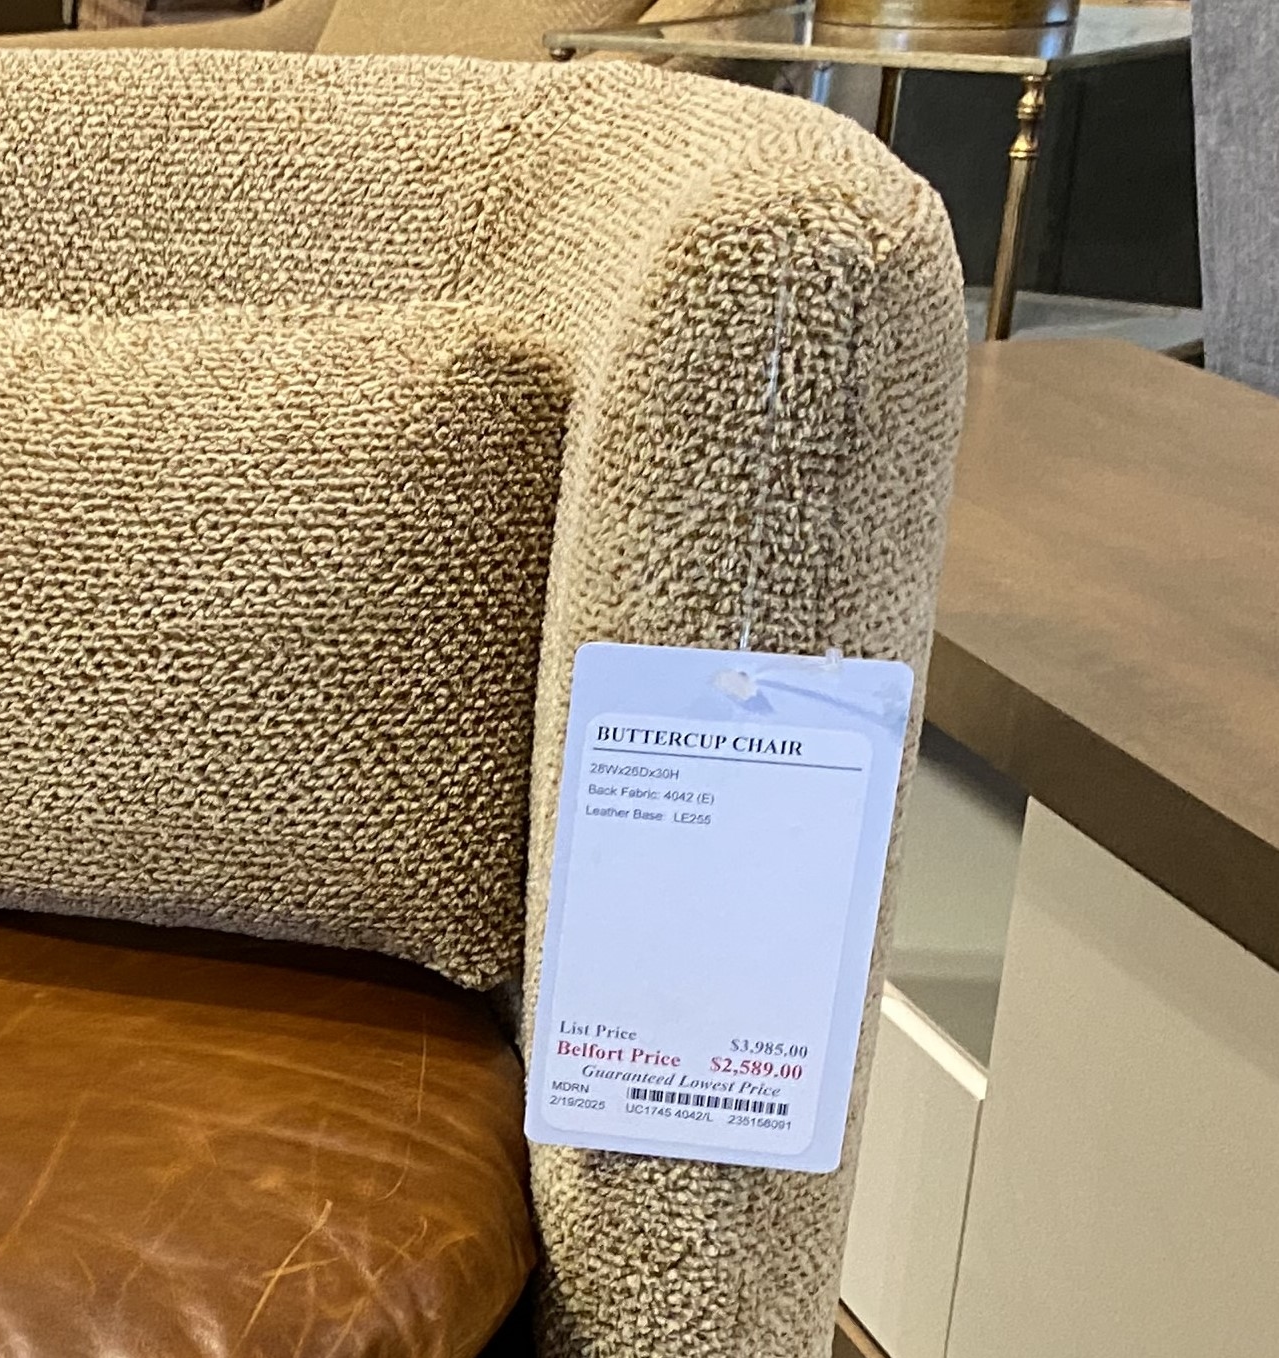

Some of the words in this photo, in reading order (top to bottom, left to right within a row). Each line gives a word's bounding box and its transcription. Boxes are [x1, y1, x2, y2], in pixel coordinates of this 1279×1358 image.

[596, 726, 727, 750] BUTTERCUP
[732, 736, 804, 756] CHAIR
[587, 783, 618, 797] Back
[663, 789, 694, 803] 4042
[696, 792, 715, 805] (E)
[585, 804, 630, 818] Leather
[559, 1020, 589, 1036] List
[596, 1024, 638, 1041] Price
[730, 1038, 808, 1059] $3,985.00
[556, 1040, 623, 1061] Belfort
[630, 1047, 682, 1068] Price
[710, 1056, 803, 1080] $2,589.00
[551, 1080, 590, 1094] MDRN
[581, 1063, 677, 1086] Guaranteed
[678, 1074, 736, 1093] Lowest
[738, 1079, 781, 1098] Price
[549, 1095, 606, 1110] 2/19/2025
[625, 1102, 672, 1117] UC1745
[674, 1109, 714, 1122] 4042/L
